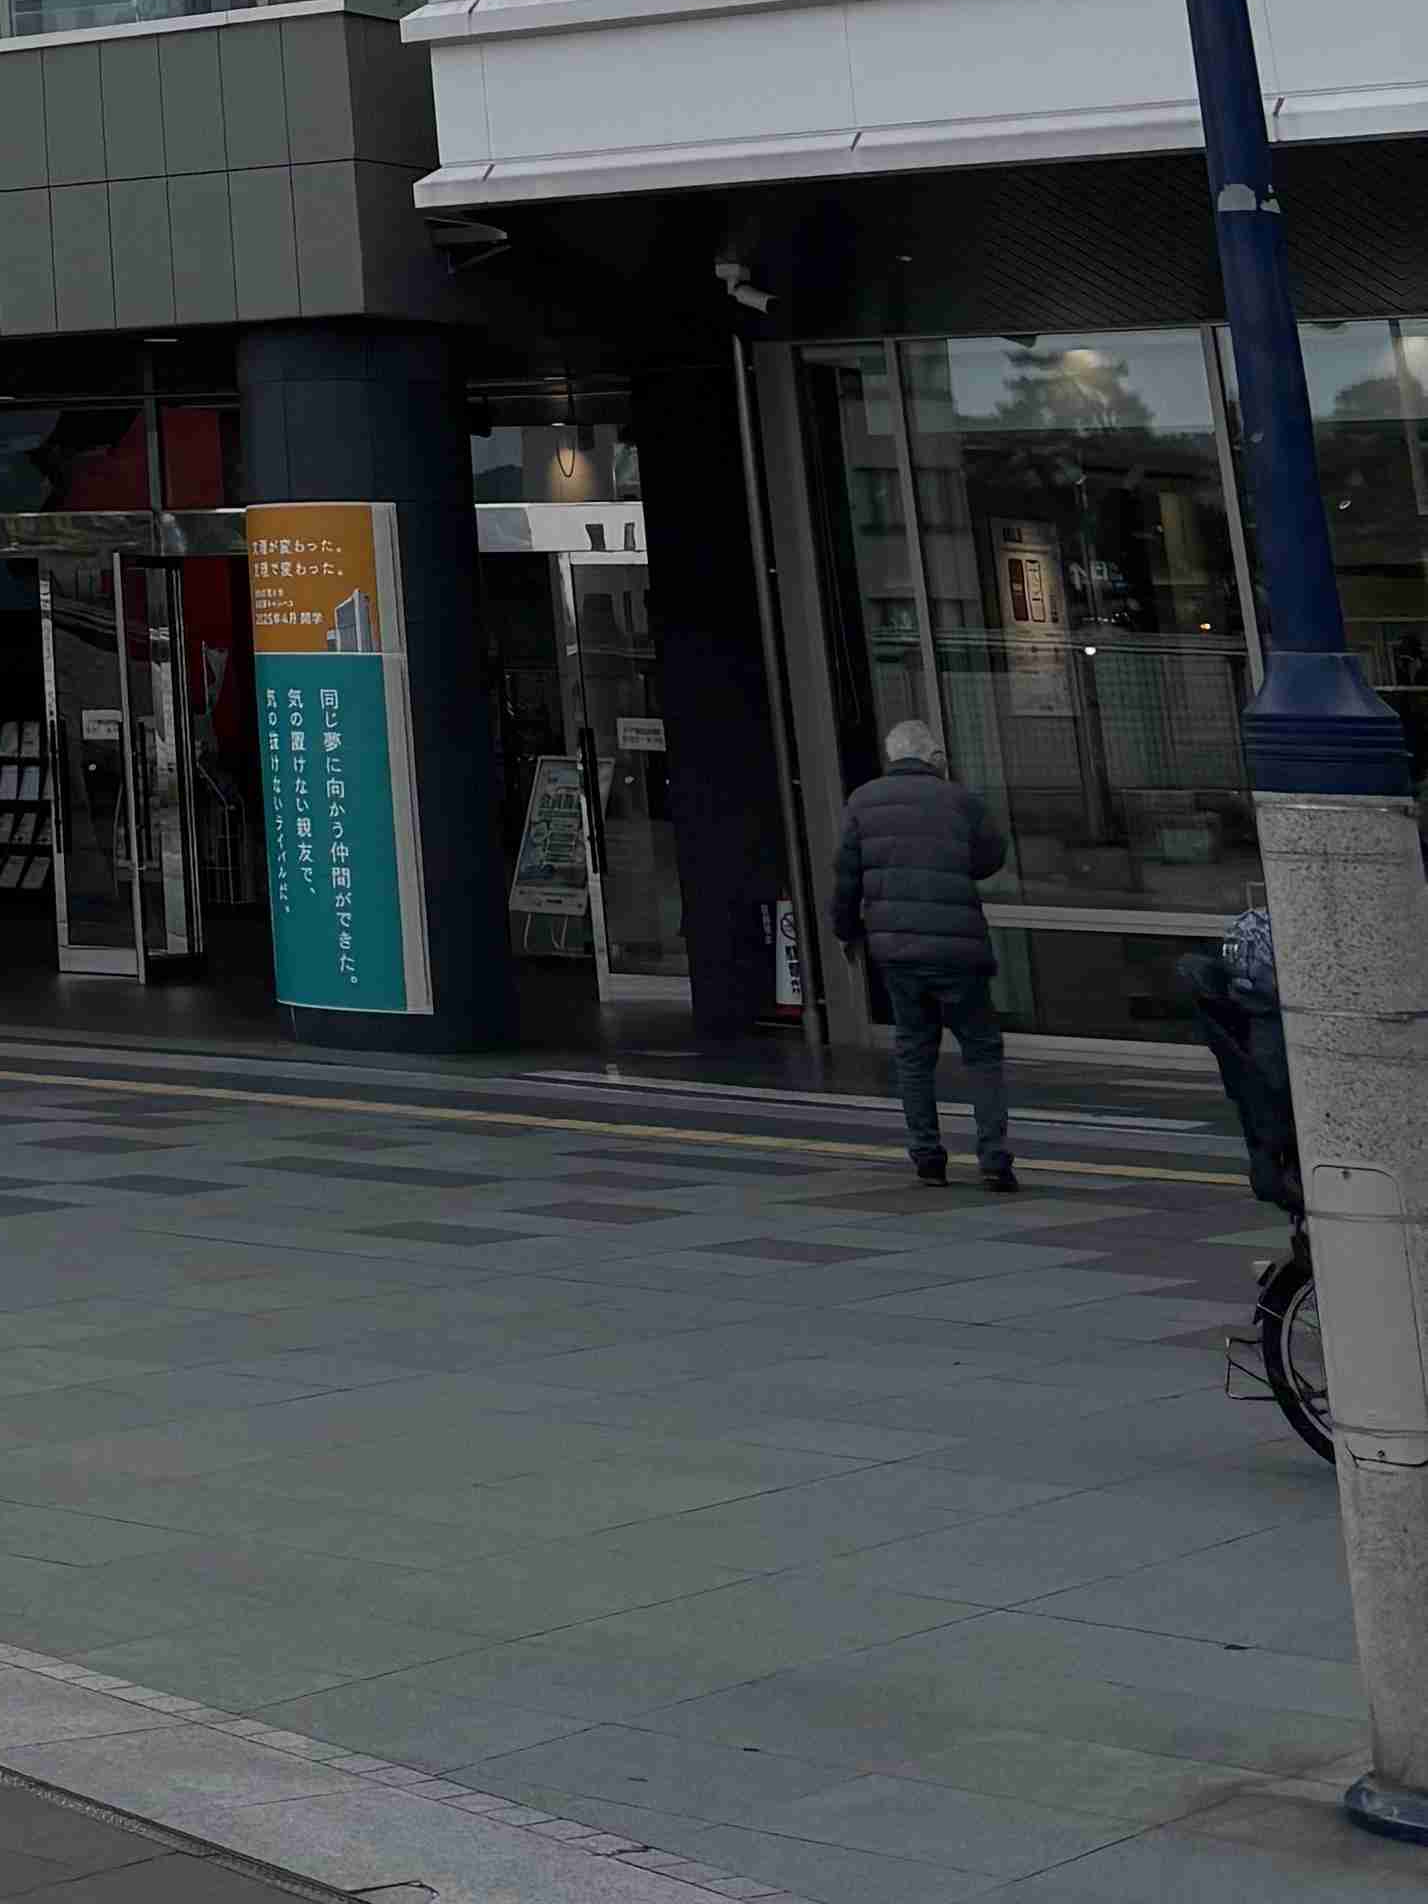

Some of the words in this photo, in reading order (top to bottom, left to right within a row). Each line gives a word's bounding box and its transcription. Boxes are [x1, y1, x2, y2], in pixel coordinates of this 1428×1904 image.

[319, 688, 358, 984] 同じ夢に向かう仲間ができた。
